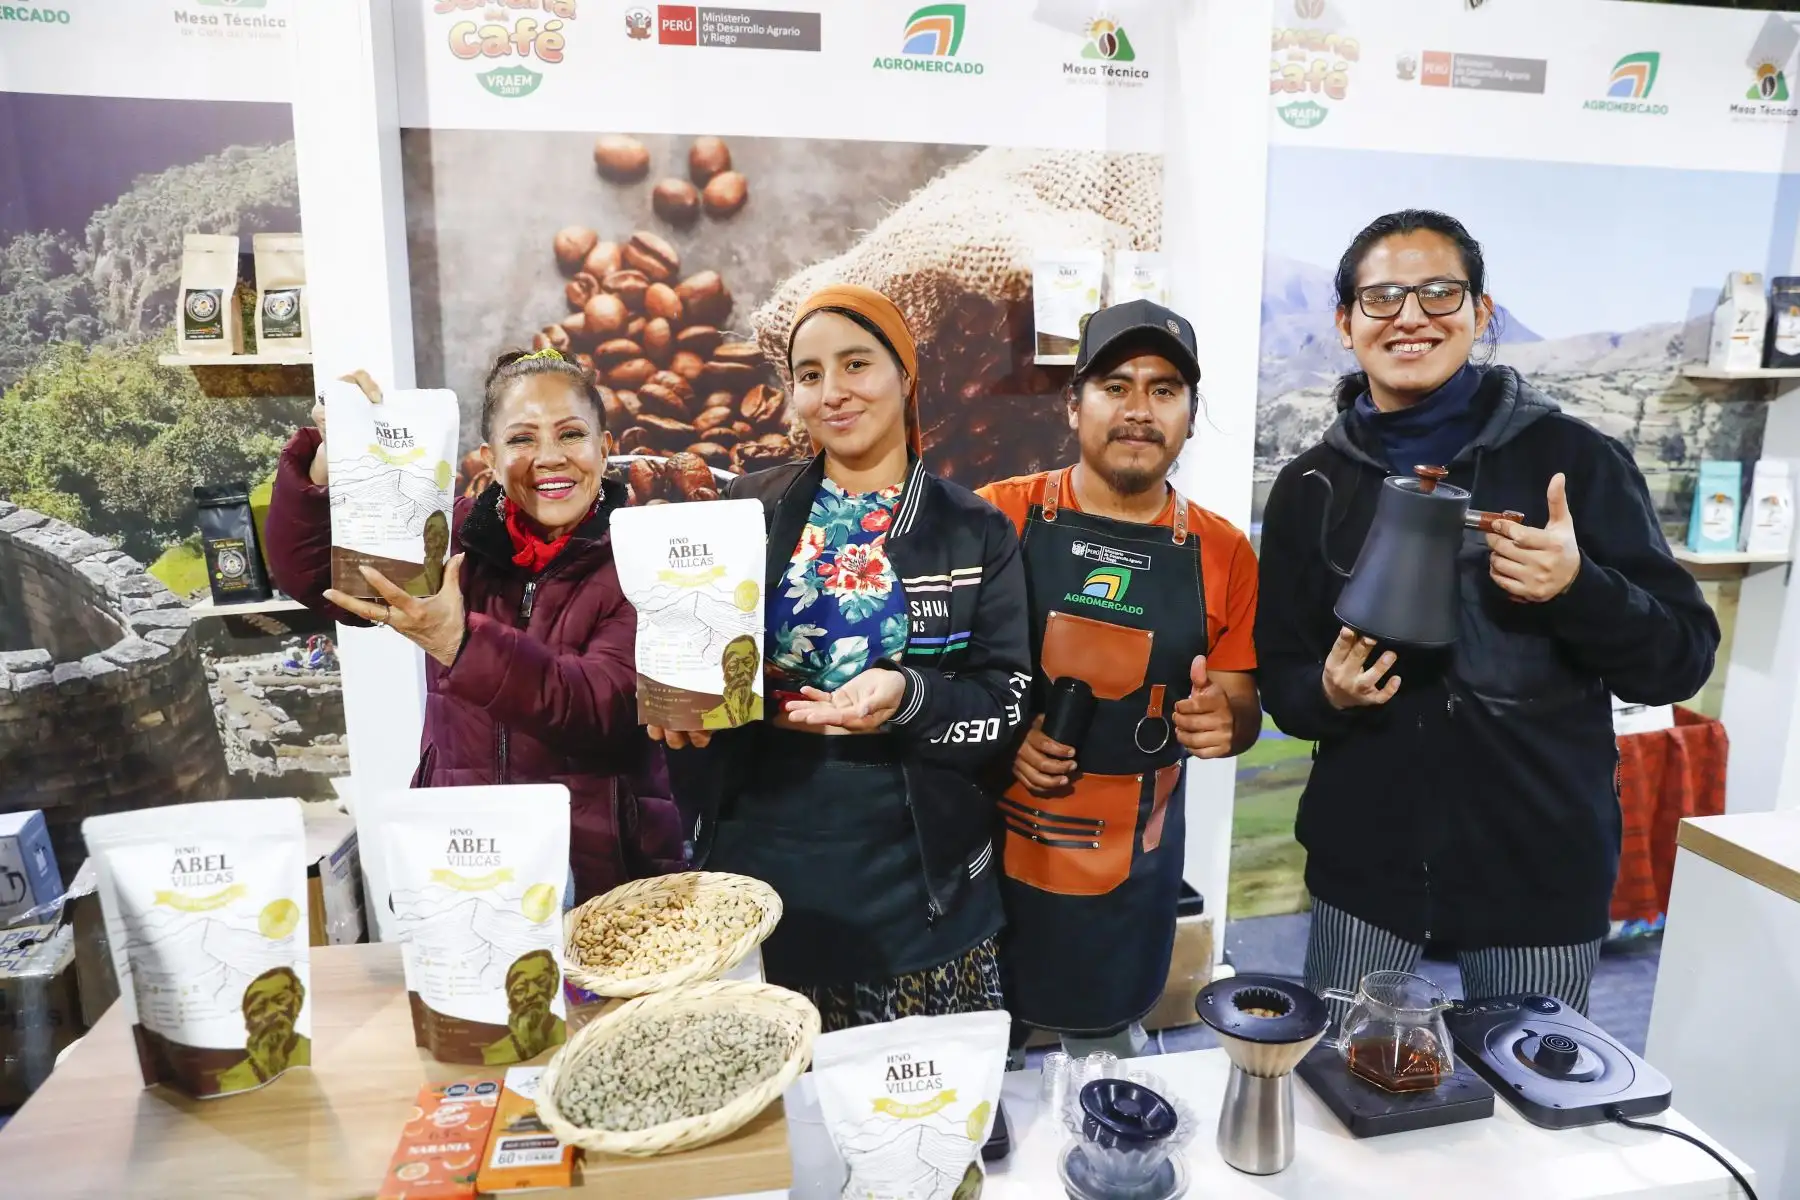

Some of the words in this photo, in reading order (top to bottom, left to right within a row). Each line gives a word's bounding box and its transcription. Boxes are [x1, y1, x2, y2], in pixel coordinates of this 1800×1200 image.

[174, 10, 218, 25] Mesa
[224, 12, 287, 28] Técnica
[662, 18, 693, 31] PERÚ
[702, 12, 751, 24] Ministerio
[702, 24, 715, 32] de
[717, 24, 765, 35] Desarrollo
[766, 26, 801, 37] Agrario
[449, 17, 565, 63] Café
[702, 34, 708, 43] y
[711, 33, 737, 45] Riego
[873, 57, 984, 75] AGROMERCADO
[1063, 62, 1096, 76] Mesa
[1100, 64, 1149, 79] Técnica
[486, 74, 533, 87] VRAEM
[1582, 100, 1669, 115] AGROMERCADO
[1730, 104, 1756, 115] Mesa
[1760, 105, 1799, 117] Técnica
[375, 426, 414, 440] ABEL
[377, 436, 415, 449] VILLCAS
[668, 543, 714, 559] ABEL
[668, 556, 714, 569] VILLCAS
[1063, 592, 1144, 615] AGROMERCADO
[912, 620, 925, 633] NS
[446, 838, 501, 854] ABEL
[171, 853, 234, 875] ABEL
[446, 855, 502, 867] VILLCAS
[171, 870, 235, 888] VILLCAS
[886, 1053, 911, 1063] HNO
[885, 1060, 942, 1081] ABEL
[885, 1077, 943, 1094] VILLCAS
[407, 1142, 472, 1155] NARANJA
